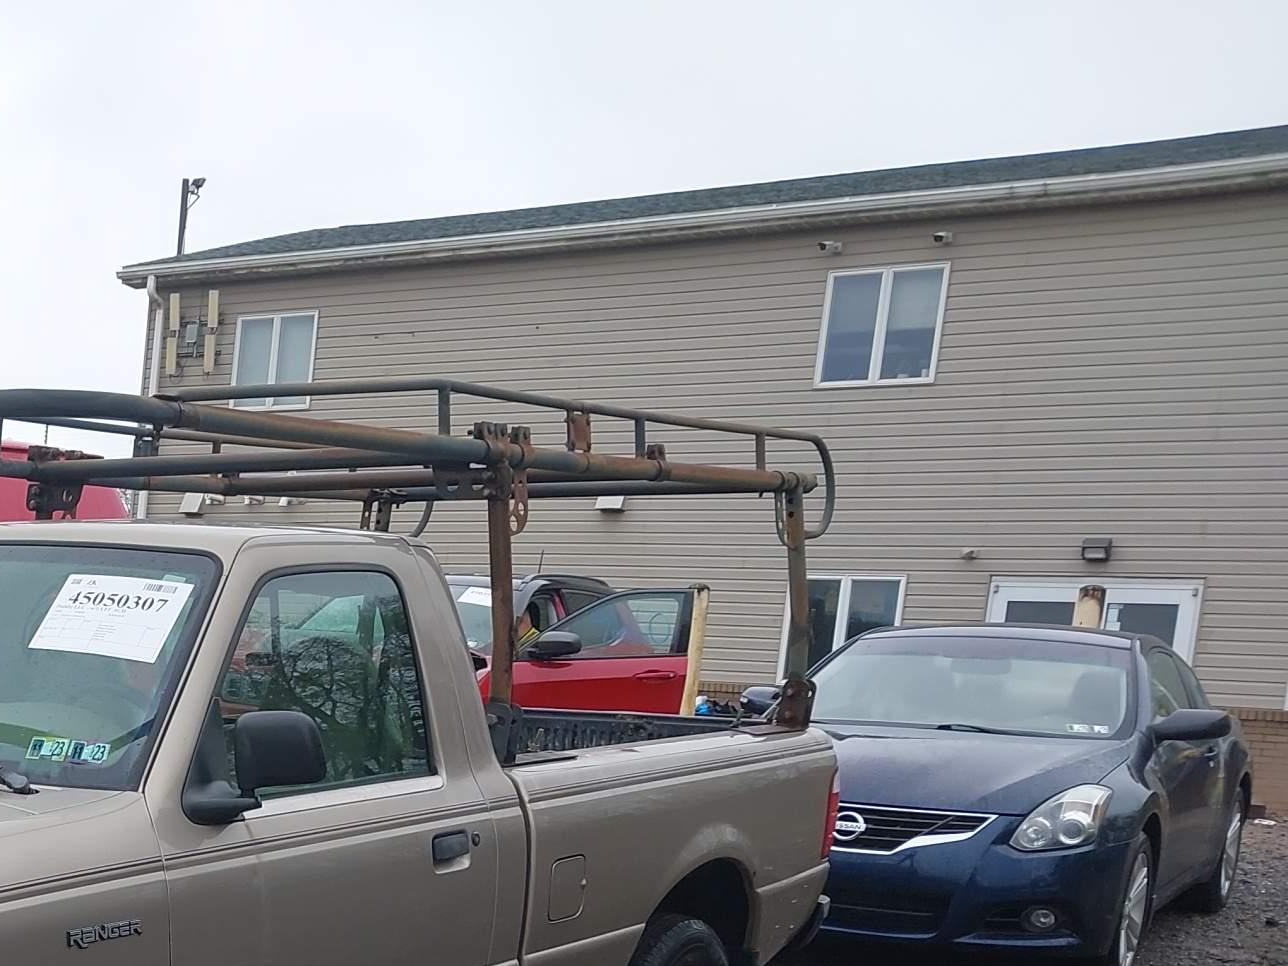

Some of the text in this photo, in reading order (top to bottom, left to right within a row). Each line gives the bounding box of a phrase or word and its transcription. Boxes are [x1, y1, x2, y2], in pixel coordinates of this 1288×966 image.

[68, 590, 169, 613] 45050307
[92, 744, 107, 761] 23
[66, 919, 143, 950] RANGER
